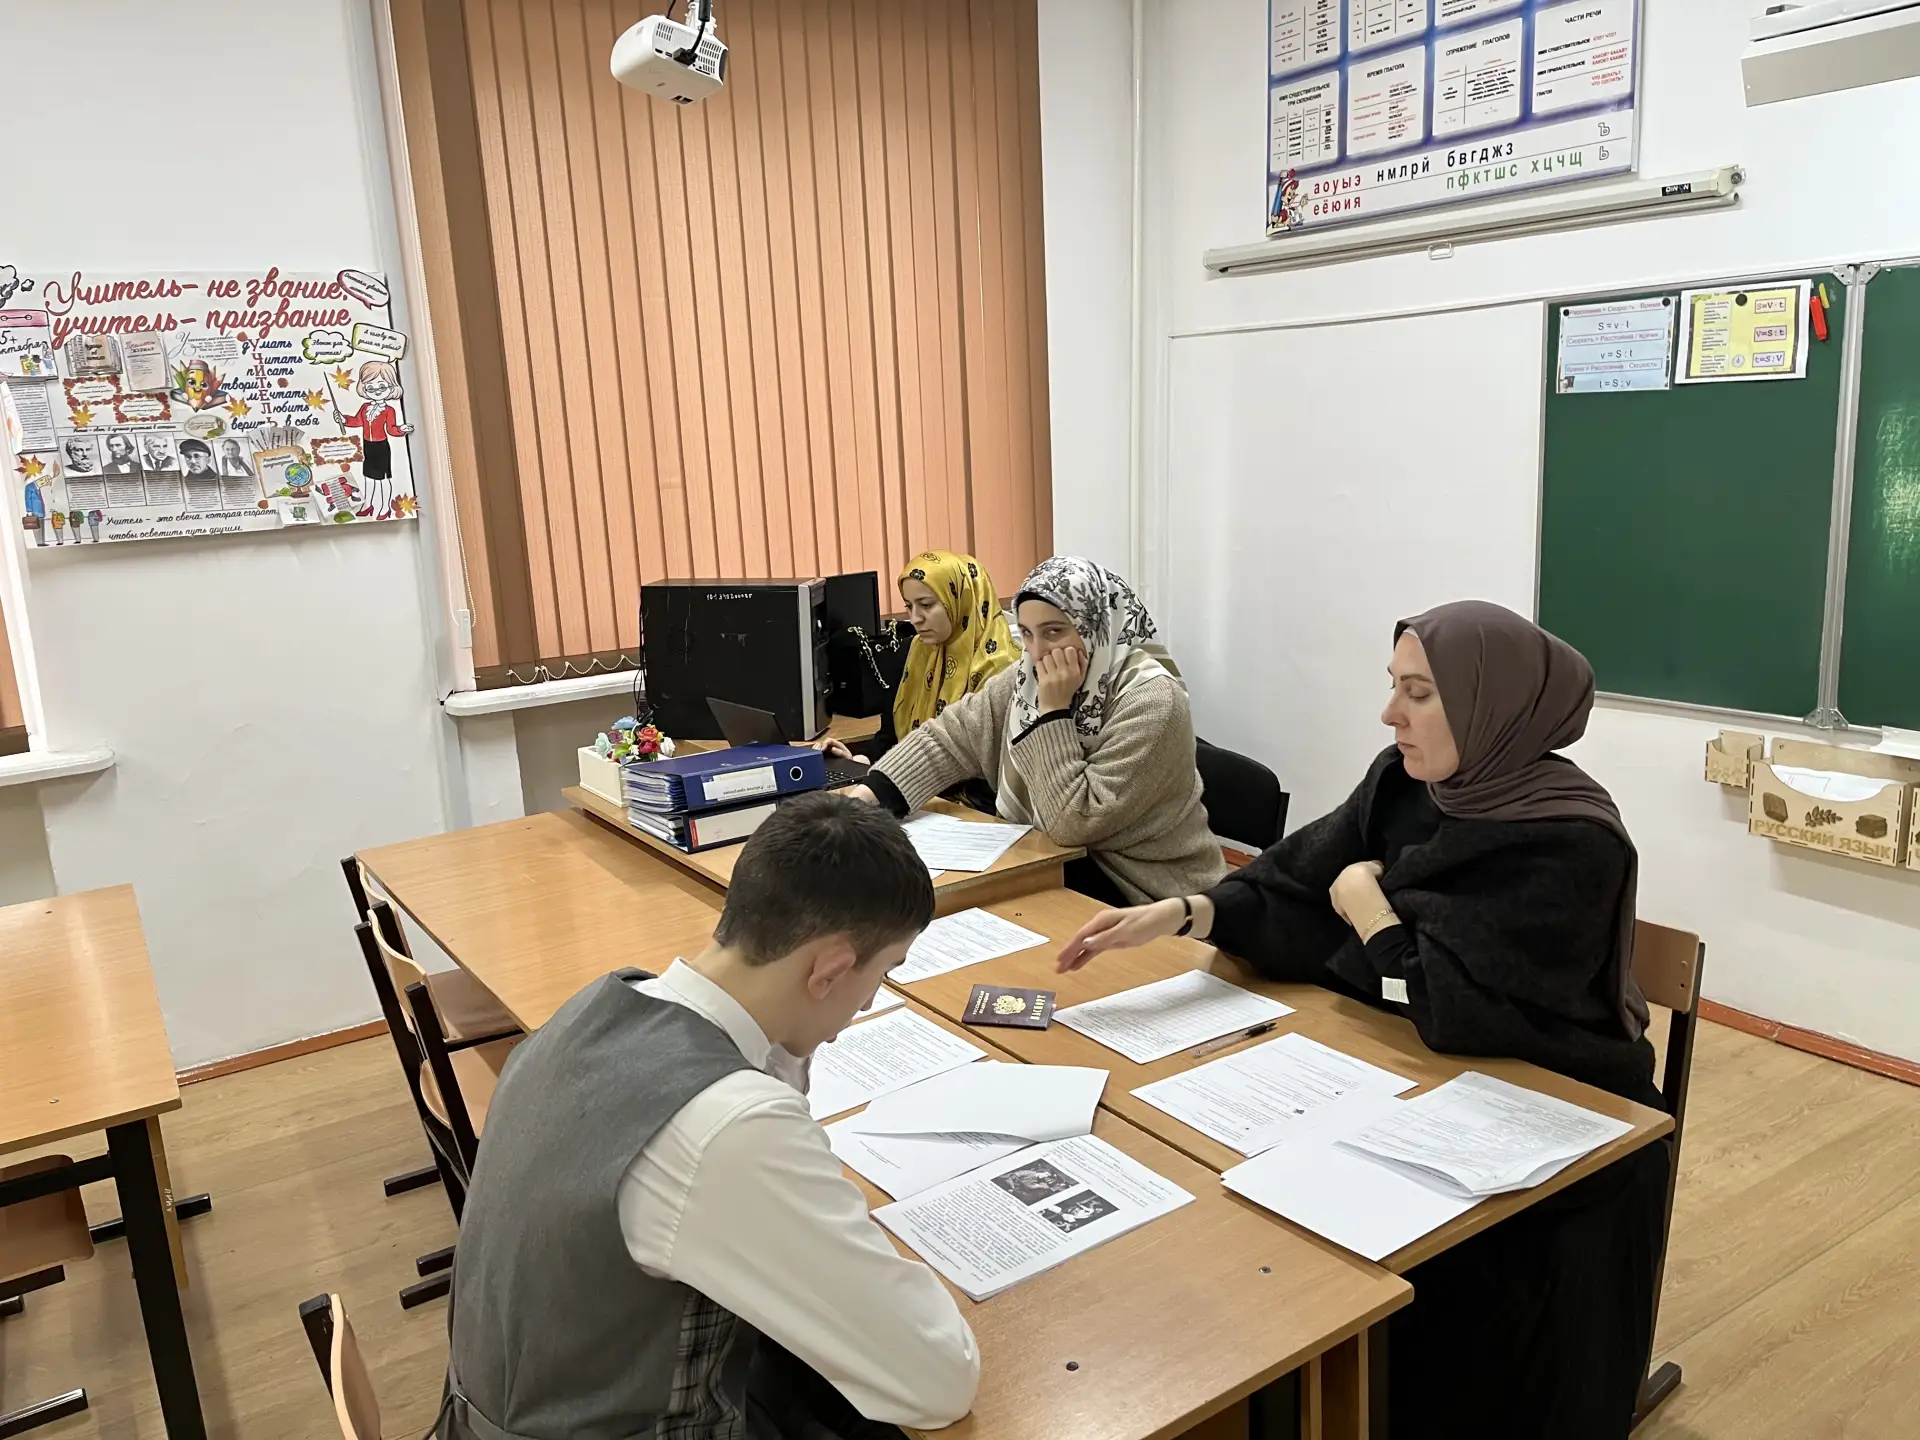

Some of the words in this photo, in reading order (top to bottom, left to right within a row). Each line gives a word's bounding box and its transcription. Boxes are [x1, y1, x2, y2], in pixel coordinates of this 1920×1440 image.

[1565, 14, 1584, 23] ЧАСТИ
[1586, 9, 1602, 18] РЕЧИ
[1446, 42, 1477, 56] СПРЯЖЕНИЕ
[1482, 33, 1510, 46] ГЛАГОЛОВ
[1548, 38, 1590, 53] СУЩЕСТВИТЕЛЬНОЕ
[1367, 69, 1383, 78] ВРЕМЯ
[1384, 63, 1405, 74] ГЛАГОЛА
[207, 279, 242, 299] не
[206, 297, 352, 340] призвание
[1598, 322, 1605, 331] S
[0, 337, 42, 355] ктября
[311, 338, 332, 346] Звонок
[332, 341, 343, 349] для
[251, 353, 303, 365] Читать
[1615, 349, 1622, 358] S
[1612, 379, 1619, 387] S
[261, 401, 310, 414] Любить
[285, 414, 292, 427] в
[295, 414, 320, 426] себя
[106, 516, 143, 526] Учитель
[156, 515, 173, 523] это
[205, 511, 241, 520] которая
[108, 530, 138, 540] чтобы
[139, 528, 183, 538] осветить
[185, 527, 207, 536] путь
[209, 524, 243, 535] другим.
[1754, 819, 1835, 847] РУССКИЙ
[1838, 837, 1891, 860] ЯЗЫК
[1029, 994, 1047, 1021] ПАСПОРТ
